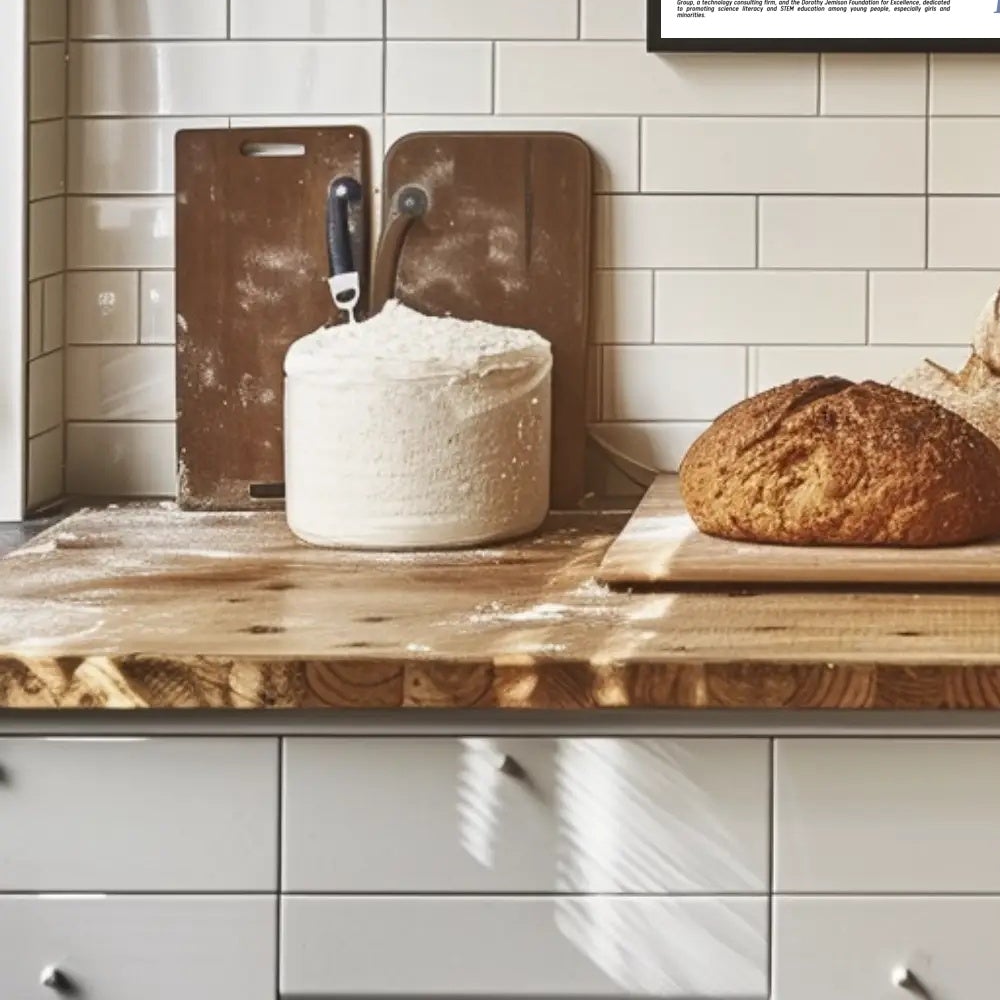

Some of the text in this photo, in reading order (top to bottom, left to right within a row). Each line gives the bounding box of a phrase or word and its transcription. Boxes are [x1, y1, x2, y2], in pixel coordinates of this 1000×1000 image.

[701, 0, 733, 7] technology
[733, 0, 763, 7] consulting
[801, 0, 823, 7] Dorothy
